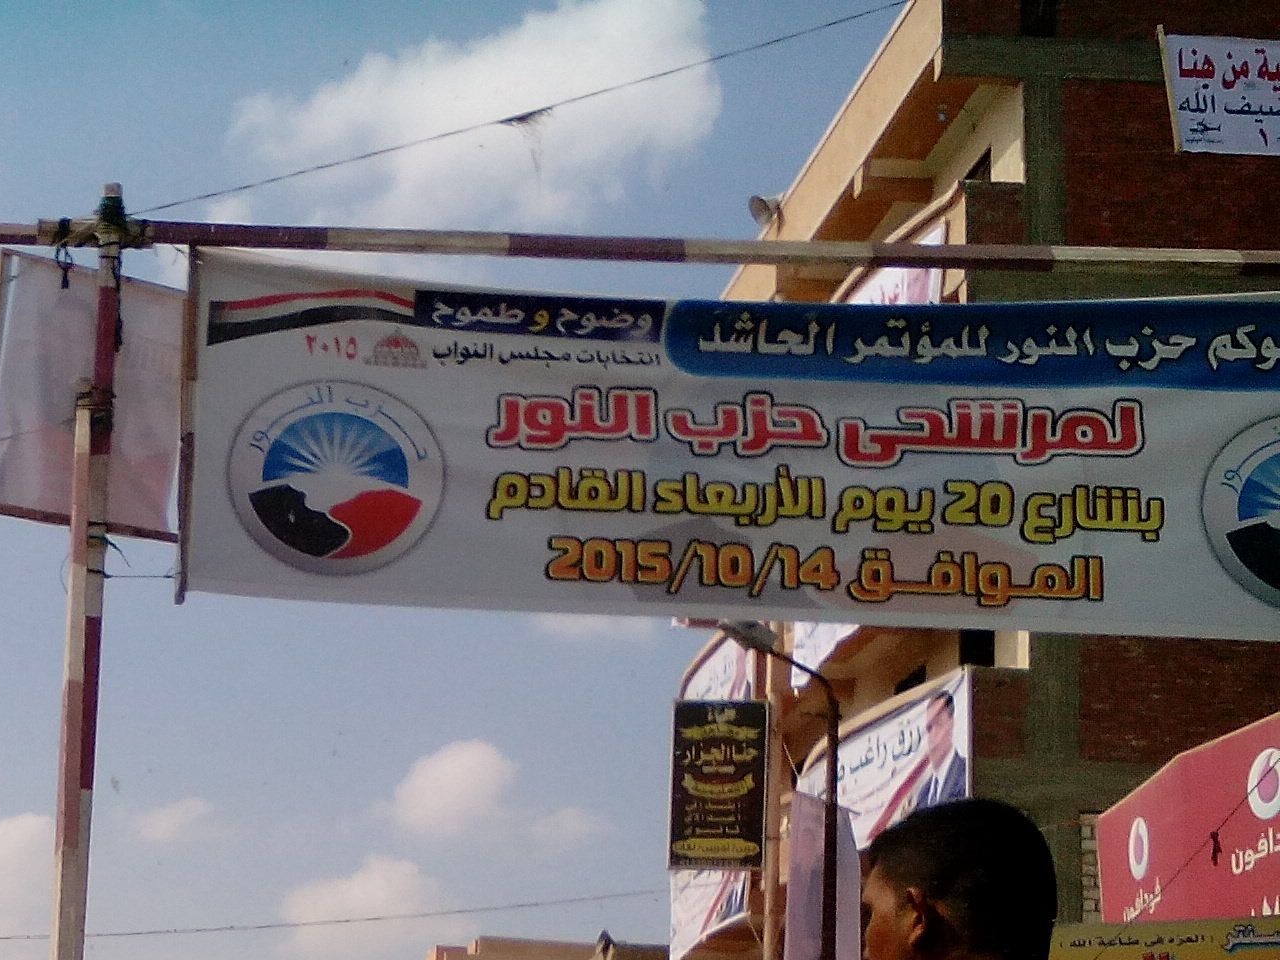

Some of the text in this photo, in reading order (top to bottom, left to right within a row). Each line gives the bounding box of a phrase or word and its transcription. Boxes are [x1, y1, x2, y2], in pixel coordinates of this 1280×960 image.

[1178, 47, 1216, 79] هنا
[1221, 51, 1250, 90] من
[1178, 83, 1216, 114] الله
[431, 299, 653, 338] وضوح و طموح
[697, 309, 835, 358] الحاشد
[843, 316, 989, 366] للمؤتمر
[432, 340, 662, 370] انتخابات مجلس النواب
[1001, 324, 1096, 367] النور
[1105, 323, 1197, 371] حزب
[486, 385, 658, 450] النور
[664, 389, 830, 457] حزب
[486, 463, 1165, 543] بشارع 20 يوم الأربعاء القادم
[545, 535, 1104, 608] الموافق 2015/10/14
